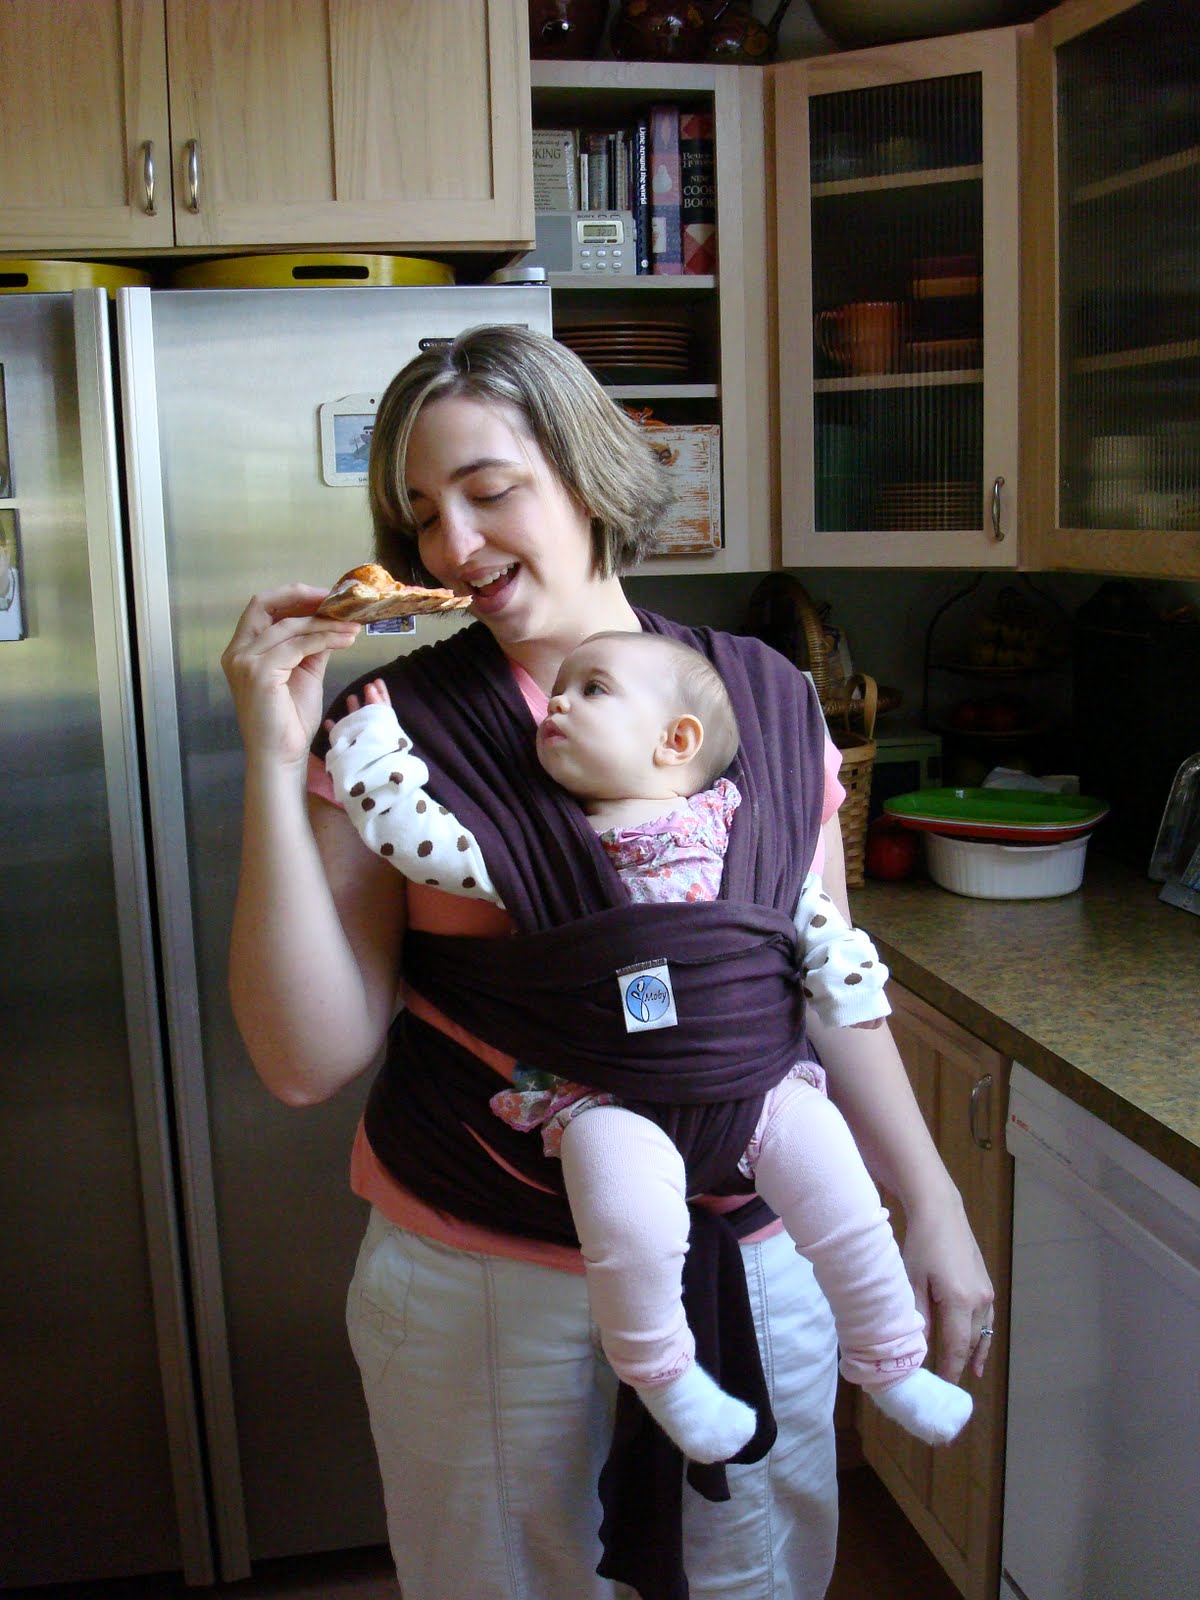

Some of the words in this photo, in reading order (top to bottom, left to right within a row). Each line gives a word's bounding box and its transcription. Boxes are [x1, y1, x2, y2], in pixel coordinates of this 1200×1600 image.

[532, 148, 562, 160] KING
[639, 145, 647, 171] around
[639, 172, 647, 183] the
[639, 184, 648, 205] world
[644, 989, 667, 1004] Moby
